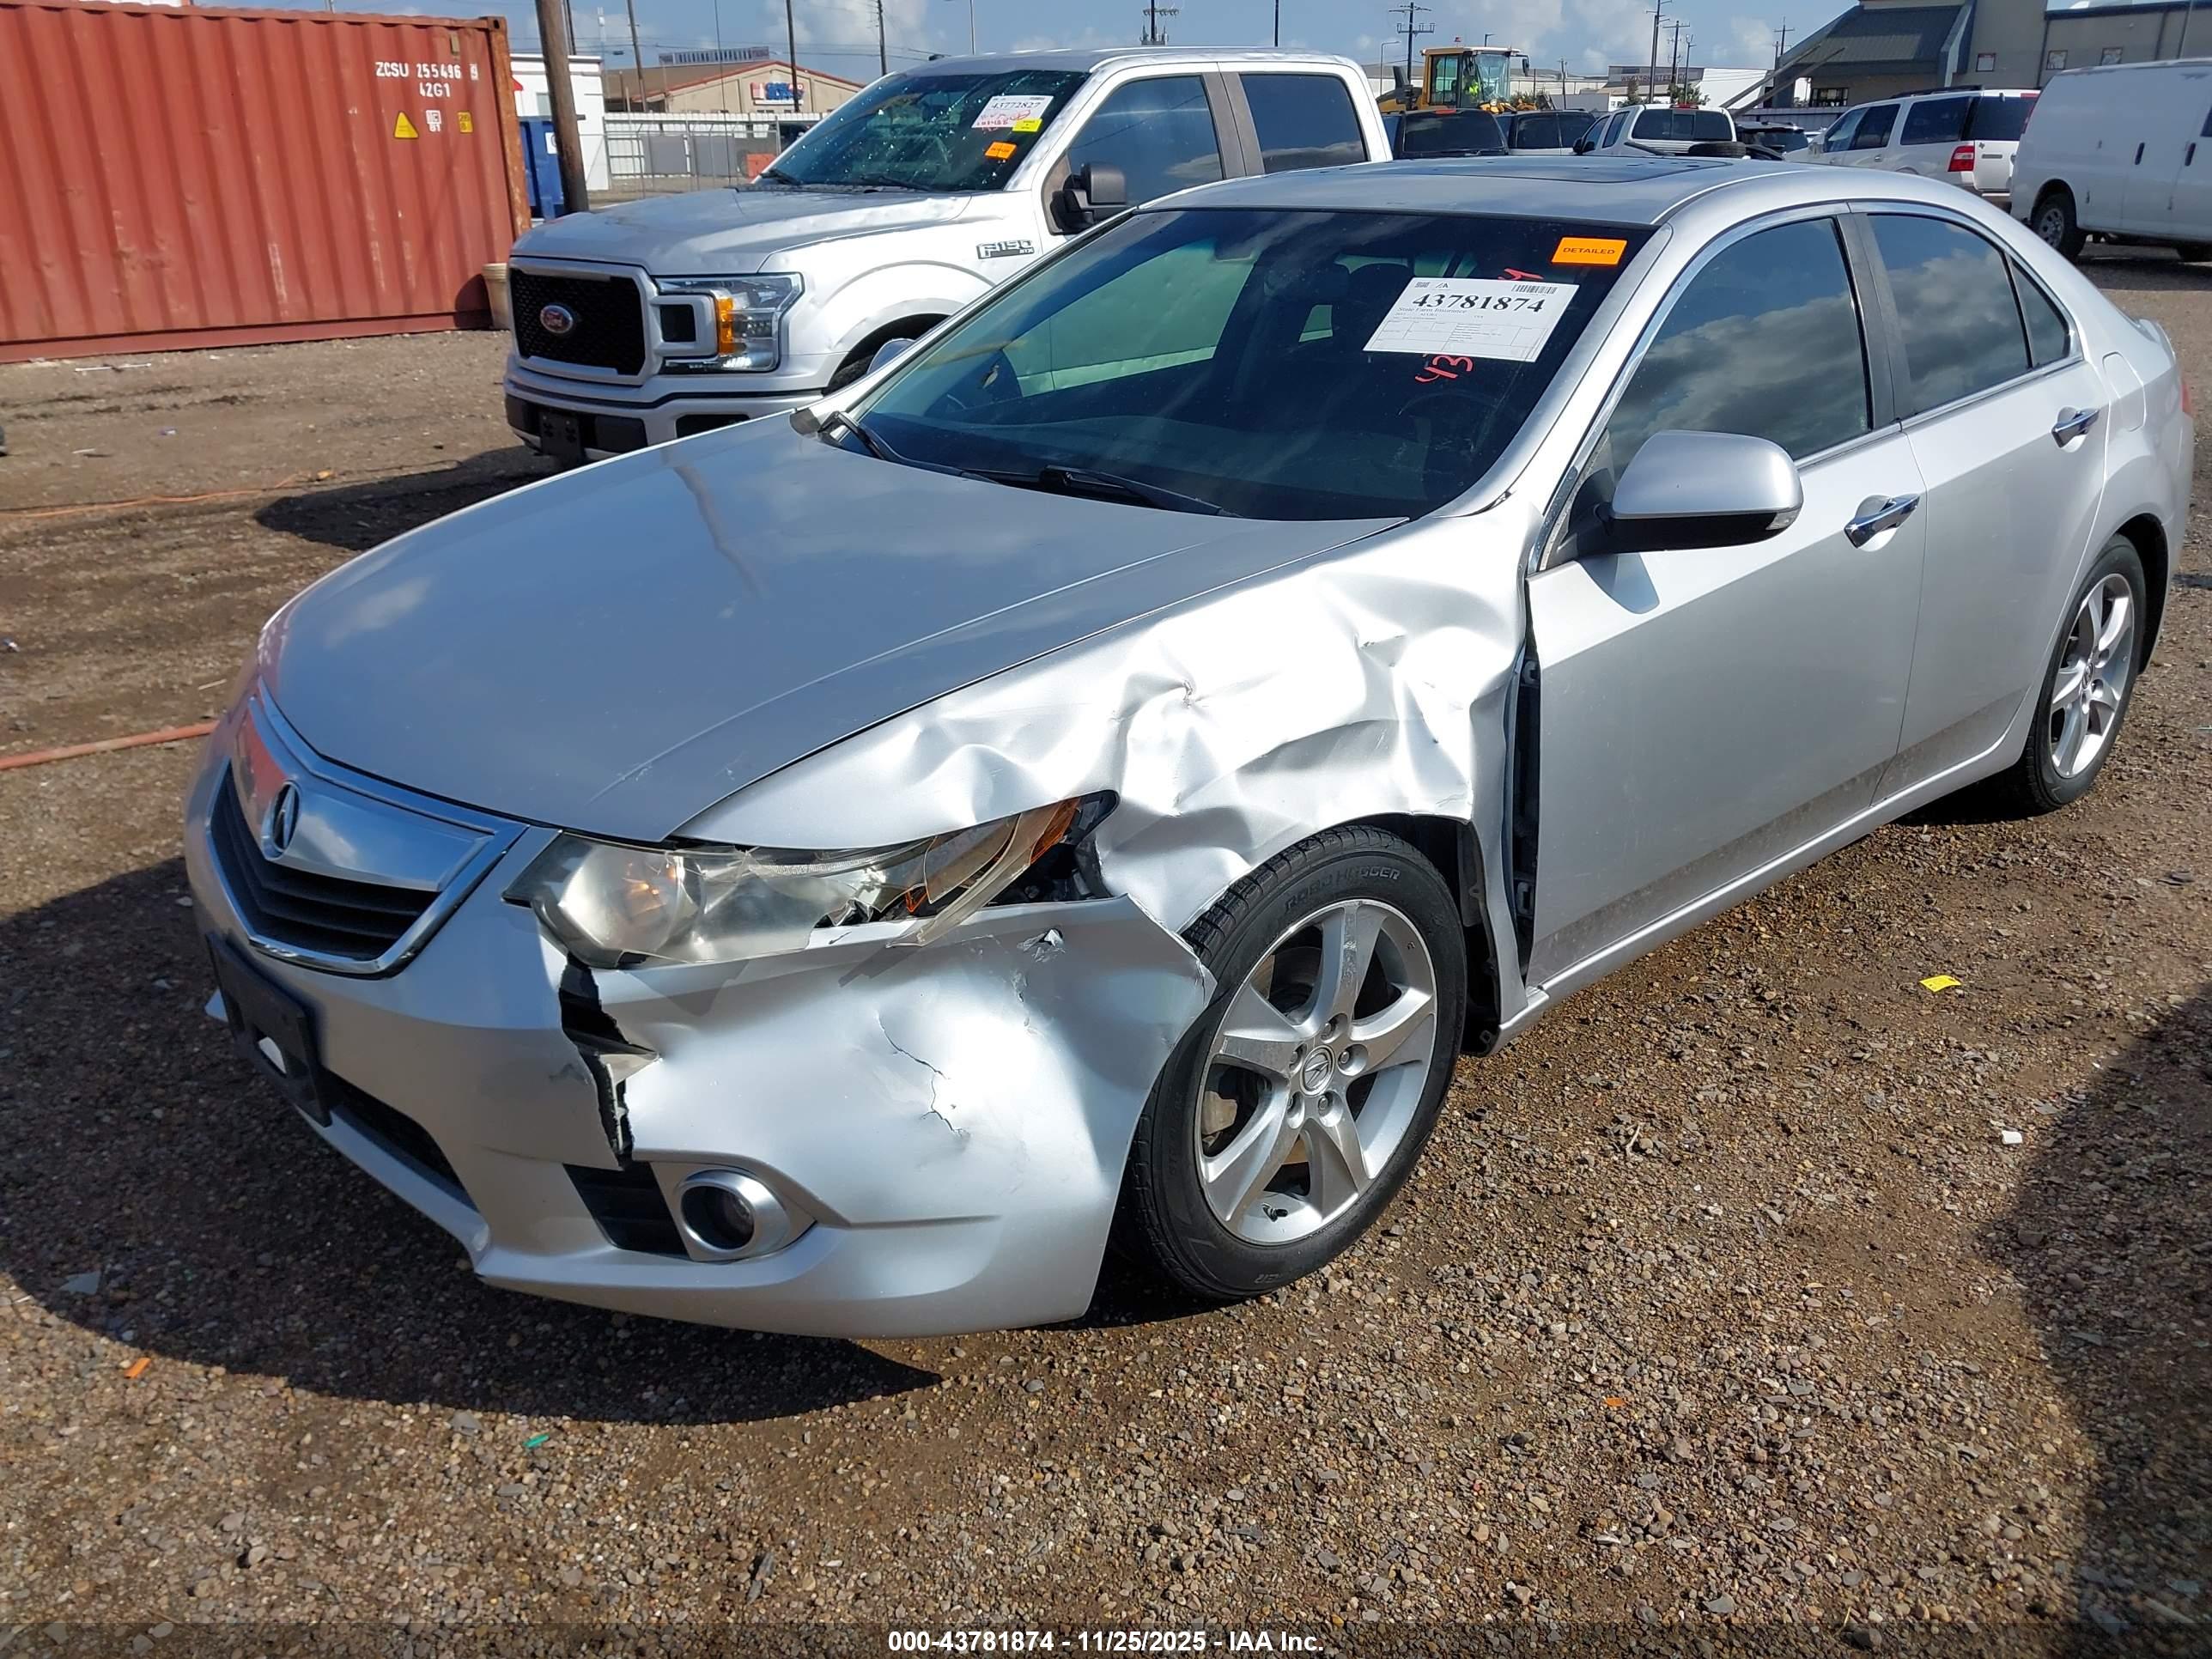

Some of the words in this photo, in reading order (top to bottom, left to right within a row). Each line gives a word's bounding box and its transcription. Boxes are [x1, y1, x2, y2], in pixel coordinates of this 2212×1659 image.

[375, 62, 409, 77] ZCSU
[416, 64, 461, 79] 255496
[419, 82, 450, 97] 42G1
[1563, 246, 1615, 255] DETAILED
[1413, 293, 1546, 313] 43781874
